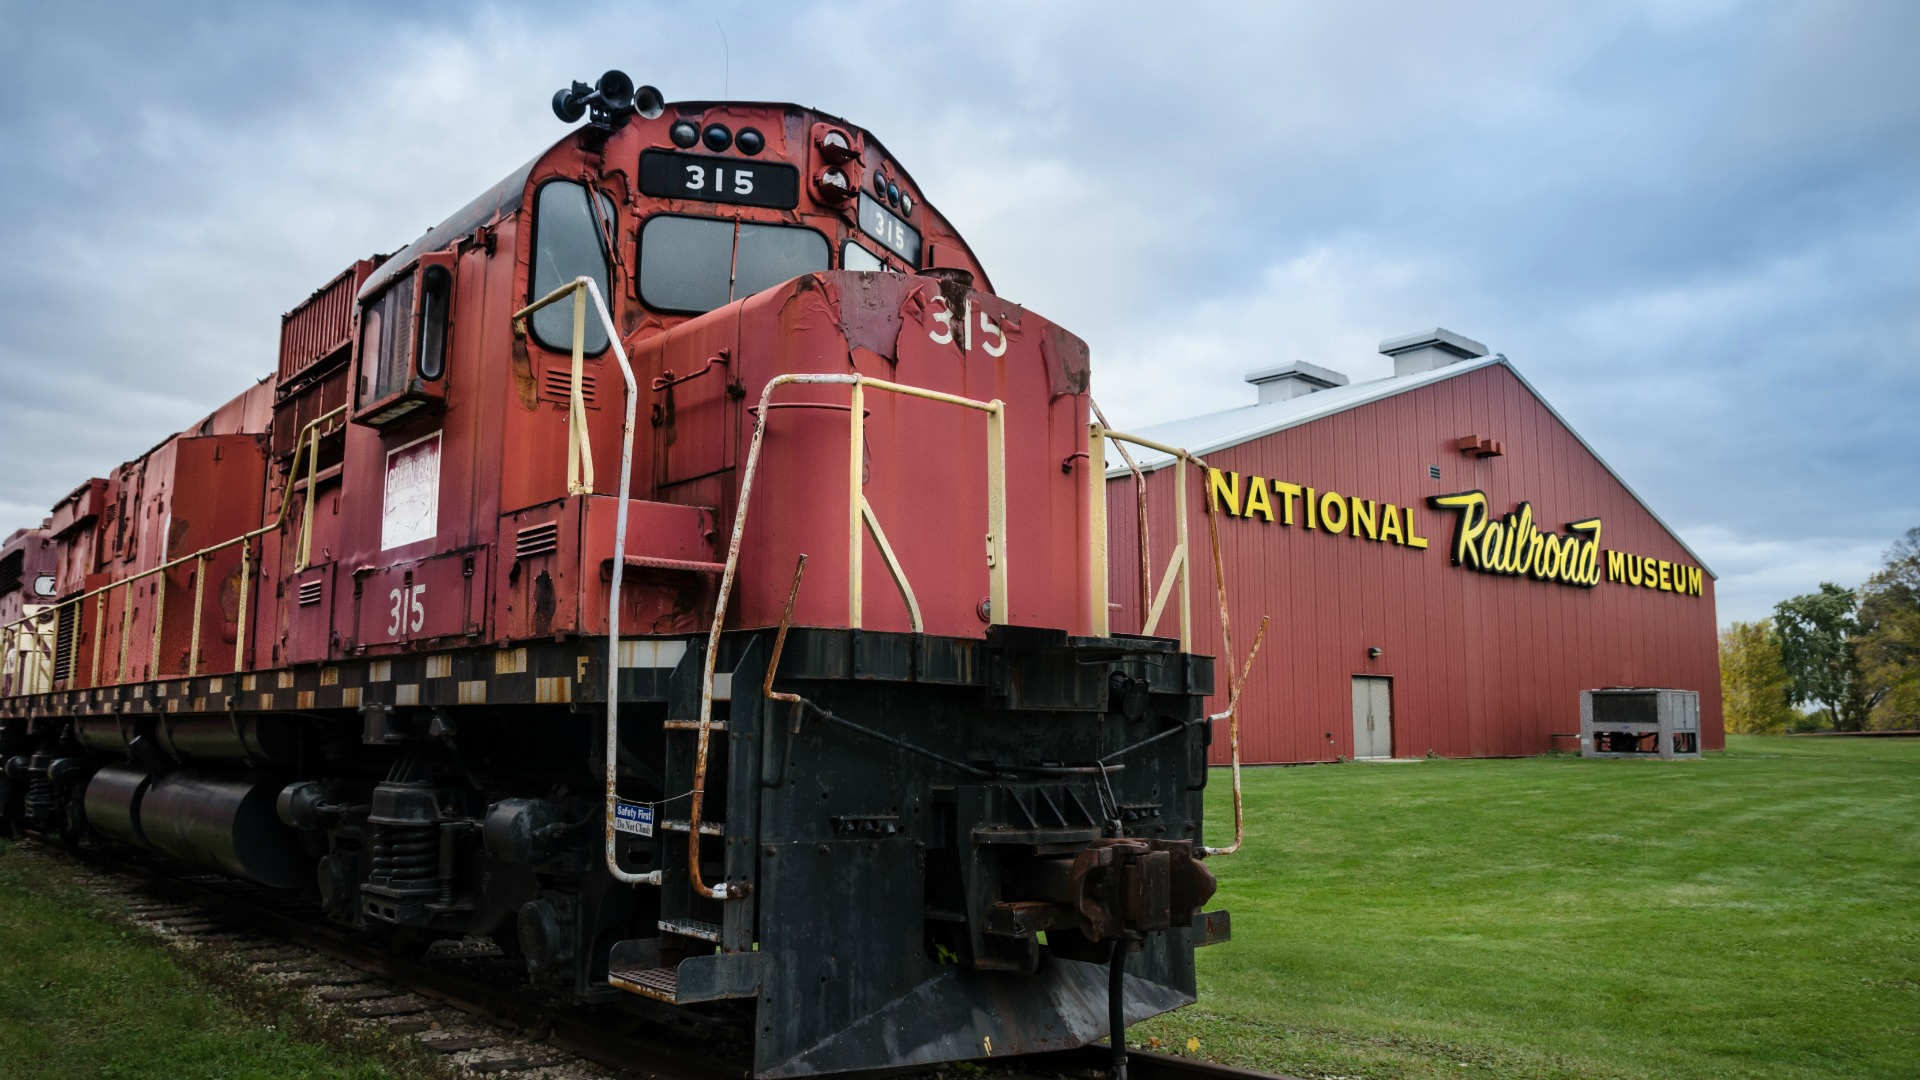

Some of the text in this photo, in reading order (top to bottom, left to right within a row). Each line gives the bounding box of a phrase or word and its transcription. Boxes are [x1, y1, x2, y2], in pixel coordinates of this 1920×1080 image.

[685, 164, 754, 195] 315
[875, 211, 905, 250] 315
[928, 295, 1008, 358] 315
[1208, 466, 1704, 596] NATIONAL Railroad MUSEUM
[388, 584, 426, 636] 315
[577, 656, 589, 684] F
[617, 806, 651, 820] Safety First
[617, 819, 650, 834] Do Not Climb
